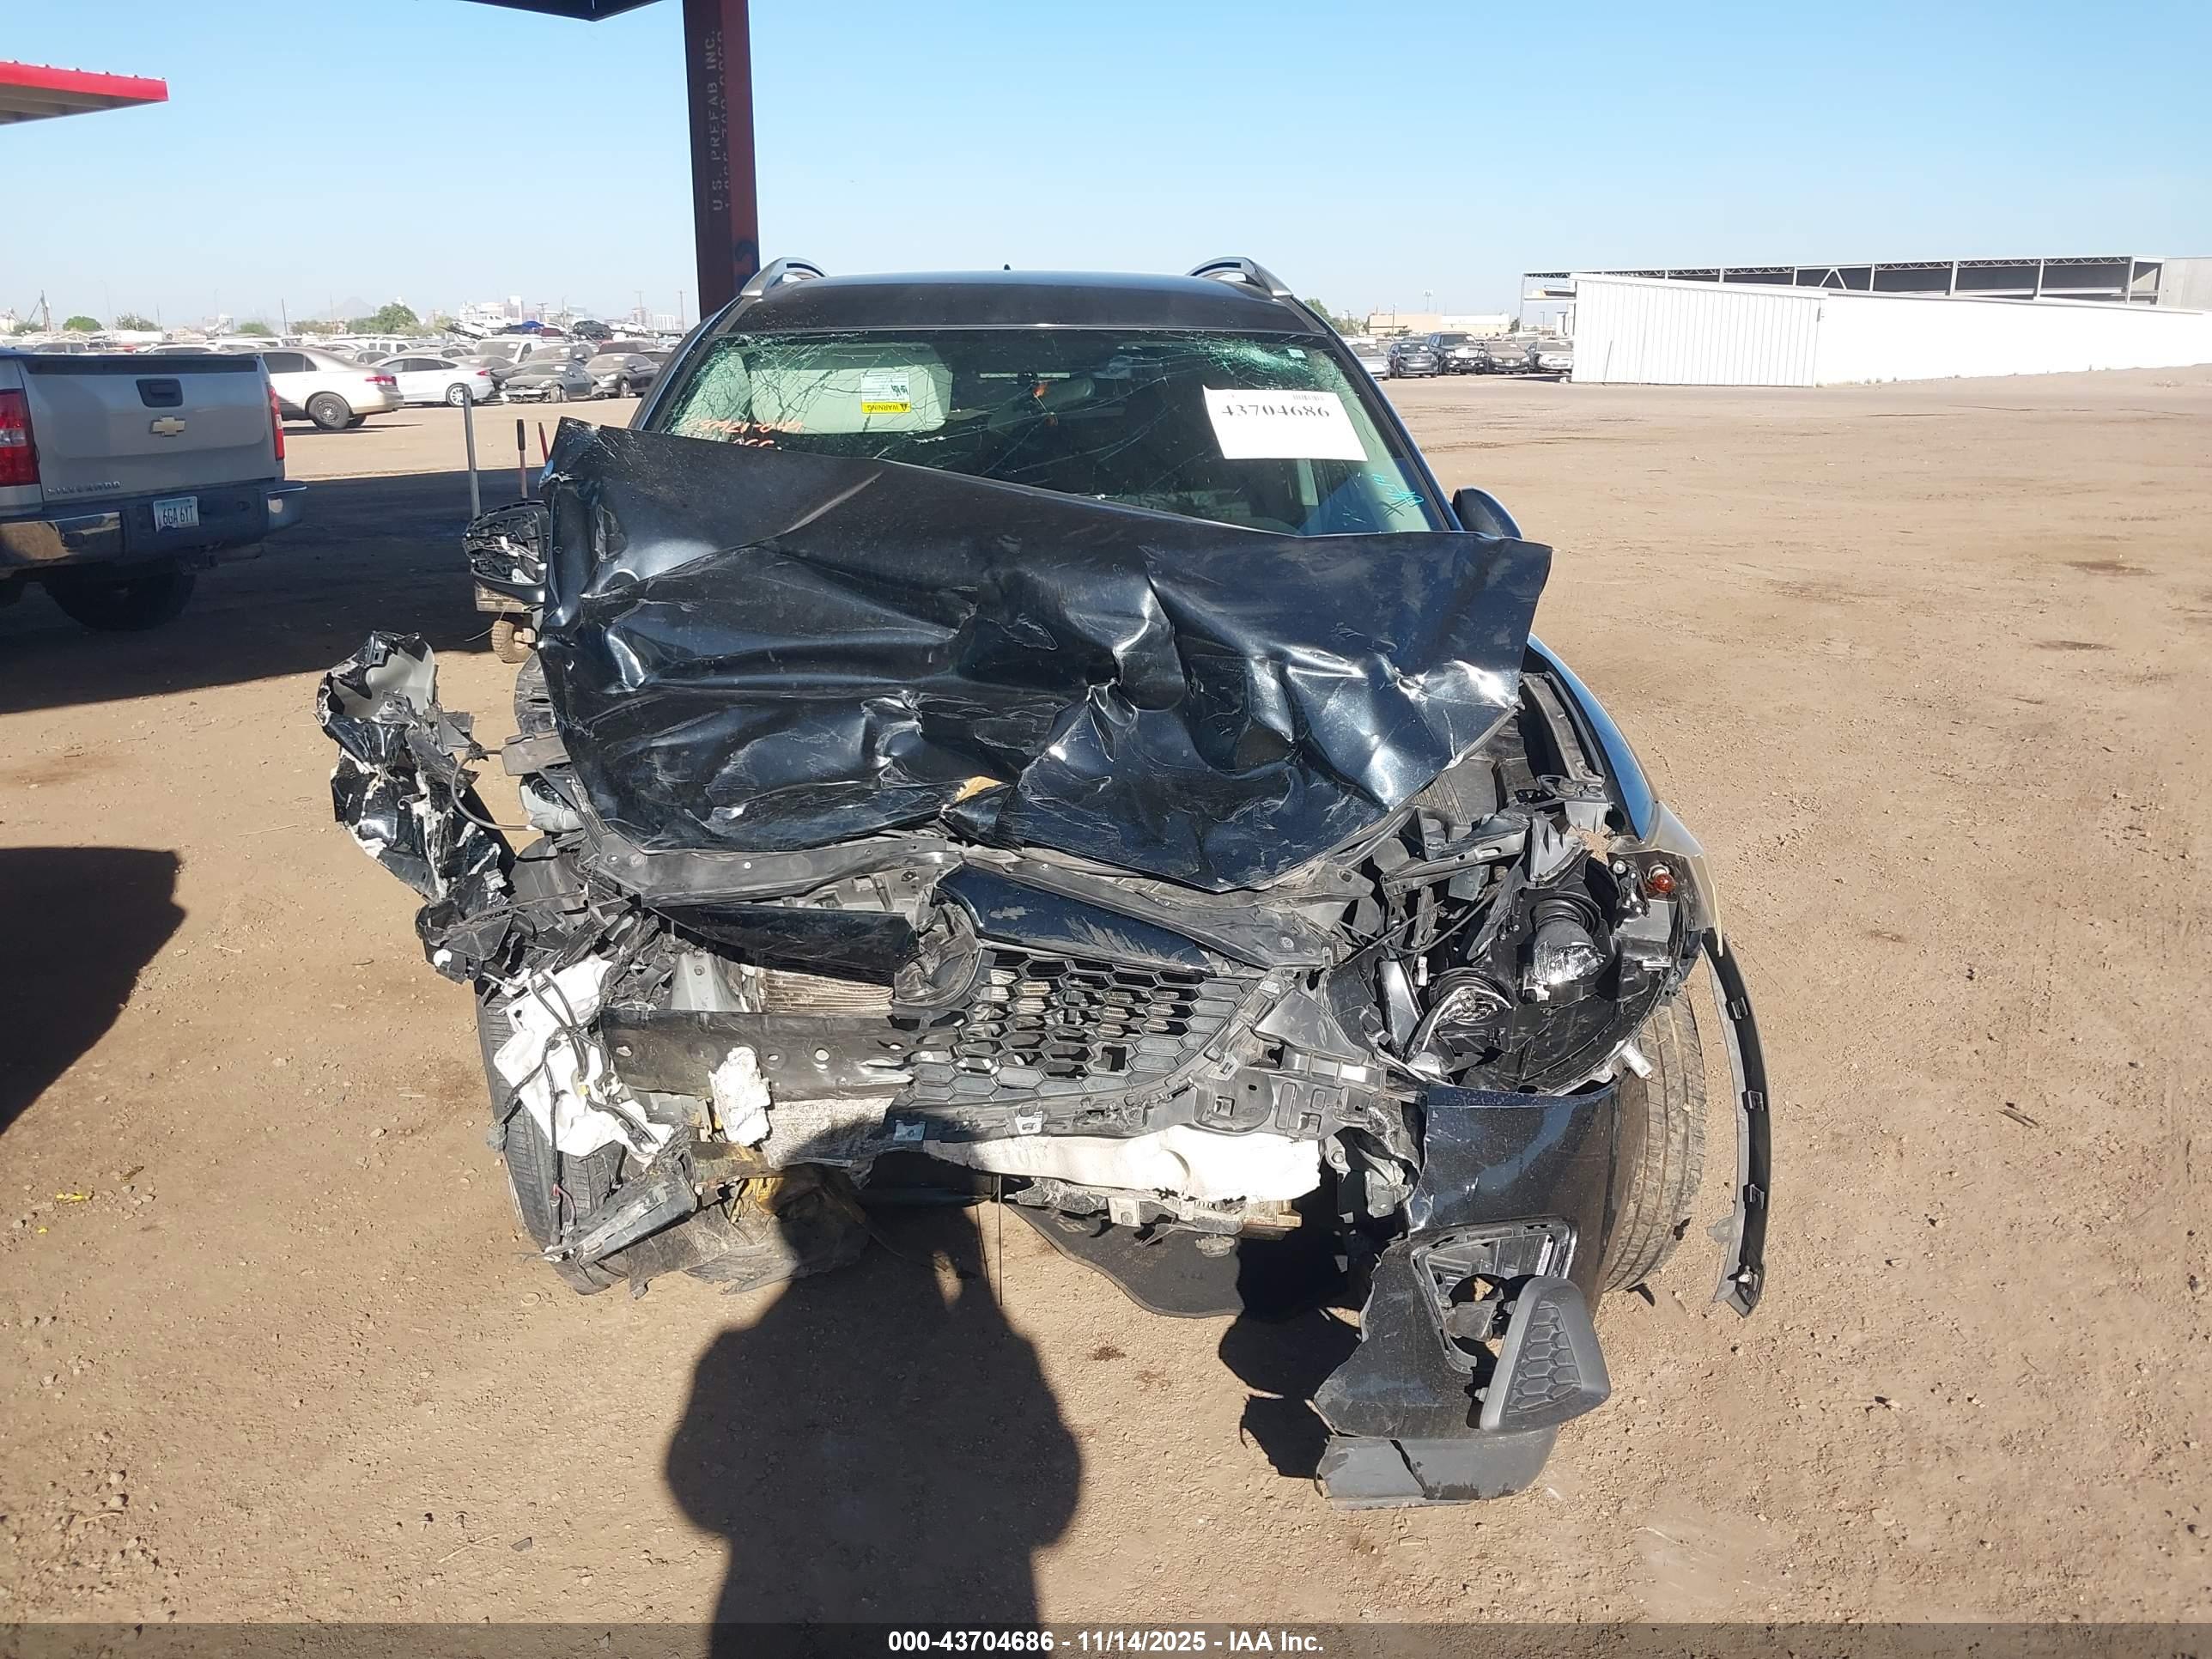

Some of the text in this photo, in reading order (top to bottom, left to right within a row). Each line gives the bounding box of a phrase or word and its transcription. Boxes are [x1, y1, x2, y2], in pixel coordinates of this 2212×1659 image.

[704, 30, 723, 211] U.S. PREFAB INC.
[1222, 404, 1330, 418] 43704686
